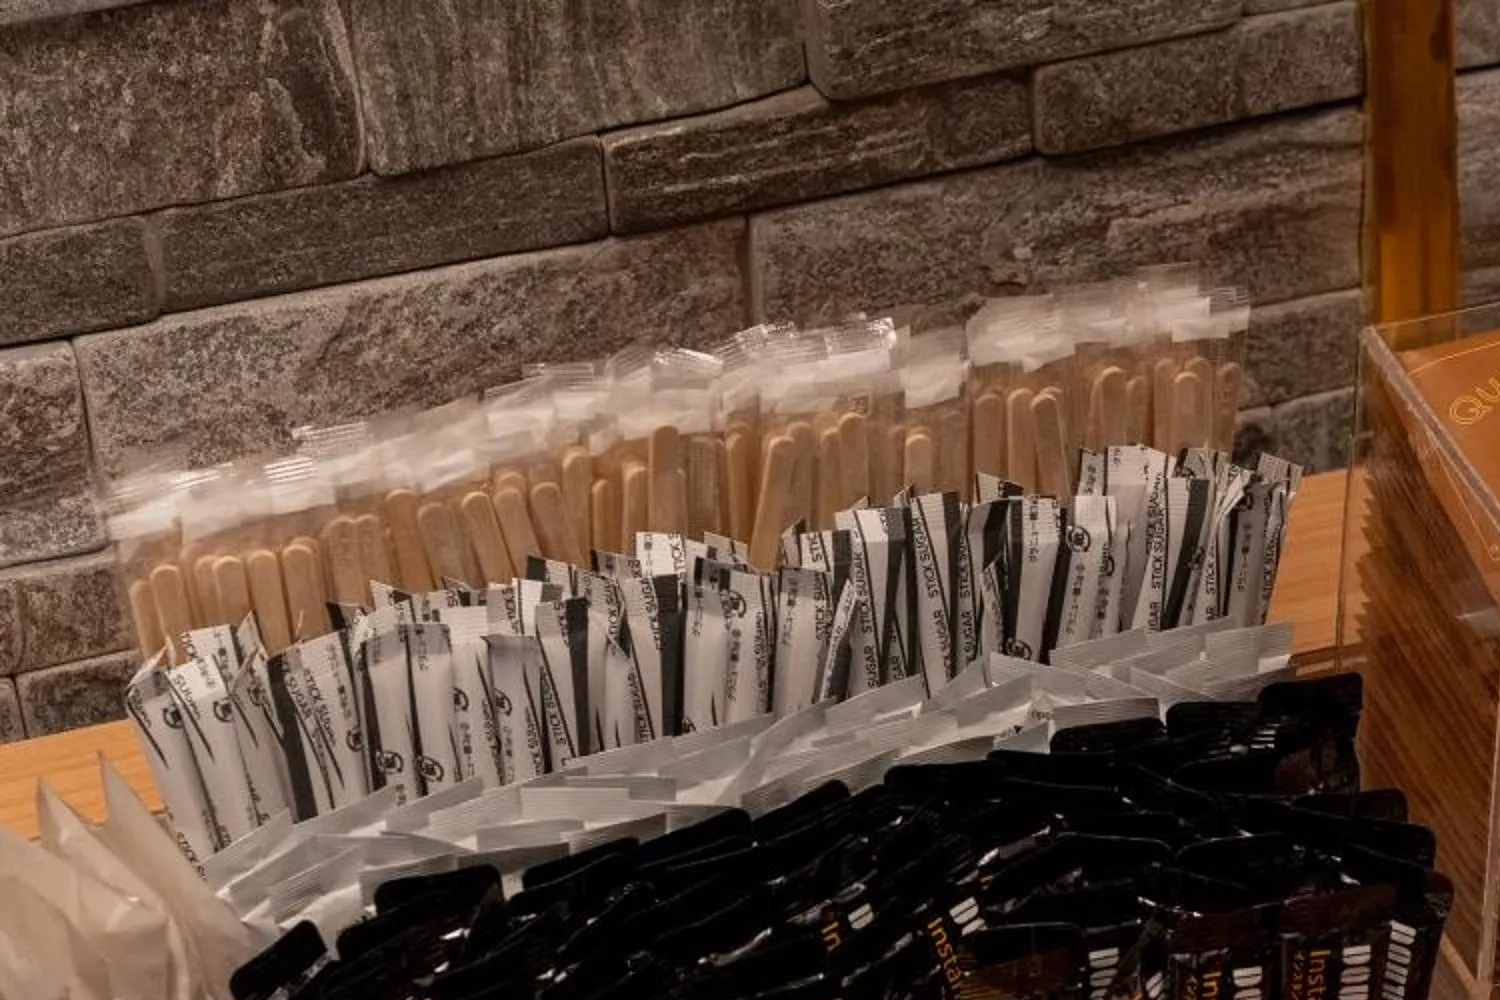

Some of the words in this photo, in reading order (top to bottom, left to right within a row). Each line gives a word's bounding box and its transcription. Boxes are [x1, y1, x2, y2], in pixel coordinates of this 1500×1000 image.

[808, 532, 823, 563] STIC
[911, 516, 931, 562] SUGAR
[1151, 507, 1165, 553] SUGAR
[852, 551, 868, 596] SUGAR
[922, 564, 939, 599] STICK
[958, 565, 971, 599] STICK
[1149, 556, 1164, 589] STICK
[1204, 558, 1216, 594] STICK
[640, 577, 657, 613] SUGA
[814, 604, 826, 641] STICK
[859, 600, 872, 633] STICK
[933, 609, 951, 653] SUGAR
[961, 610, 976, 654] SUGAR
[864, 645, 879, 688] SUGAR
[928, 916, 963, 994] Insta
